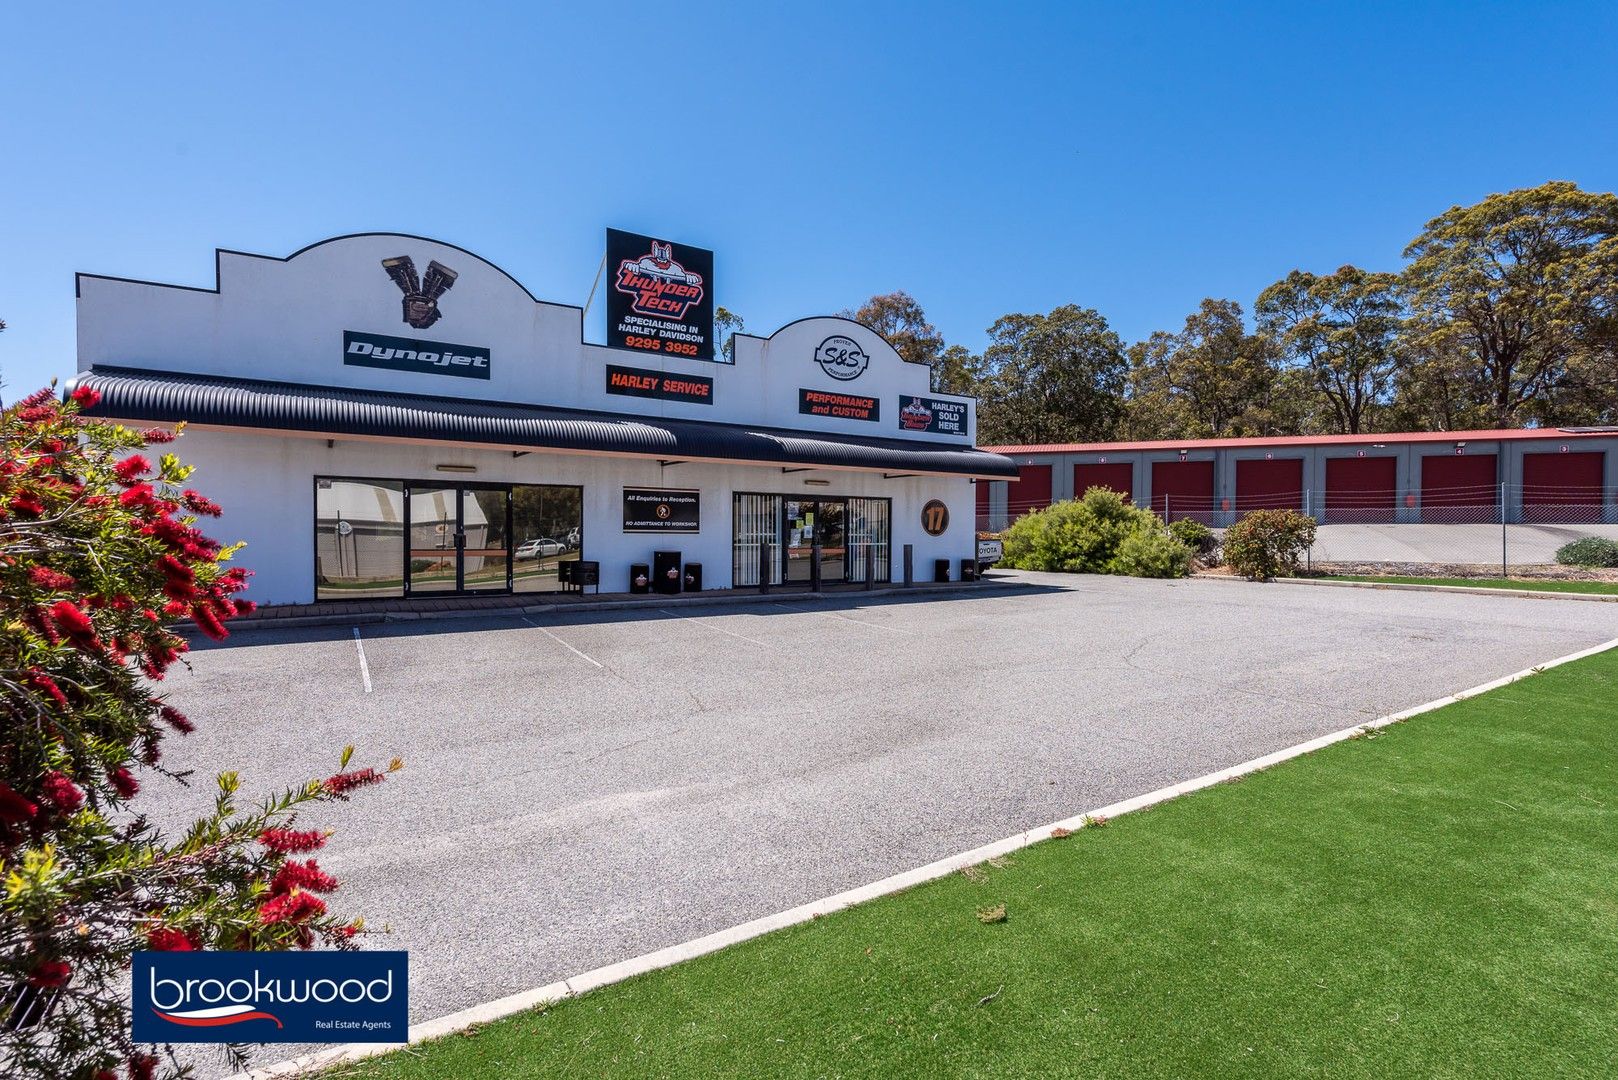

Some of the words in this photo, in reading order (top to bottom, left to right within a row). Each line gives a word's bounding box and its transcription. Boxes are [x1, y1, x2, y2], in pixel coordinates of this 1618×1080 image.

[621, 270, 700, 298] THUNDER
[637, 290, 684, 313] TECH
[618, 323, 657, 336] HARLEY
[659, 329, 704, 344] DAVIDSON
[624, 315, 687, 332] SPECIALISING
[689, 325, 699, 334] IN
[347, 341, 488, 367] Dynojet
[625, 335, 661, 350] 9295
[665, 341, 698, 356] 3952
[822, 347, 861, 367] S&S
[611, 373, 660, 390] HARLEY
[663, 379, 710, 396] SERVICE
[805, 392, 875, 408] PERFORMANCE
[931, 402, 965, 413] HARLEY'S
[812, 405, 830, 415] and
[832, 406, 869, 418] CUSTOM
[938, 411, 960, 421] SOLD
[938, 421, 960, 431] HERE
[926, 506, 944, 531] 17
